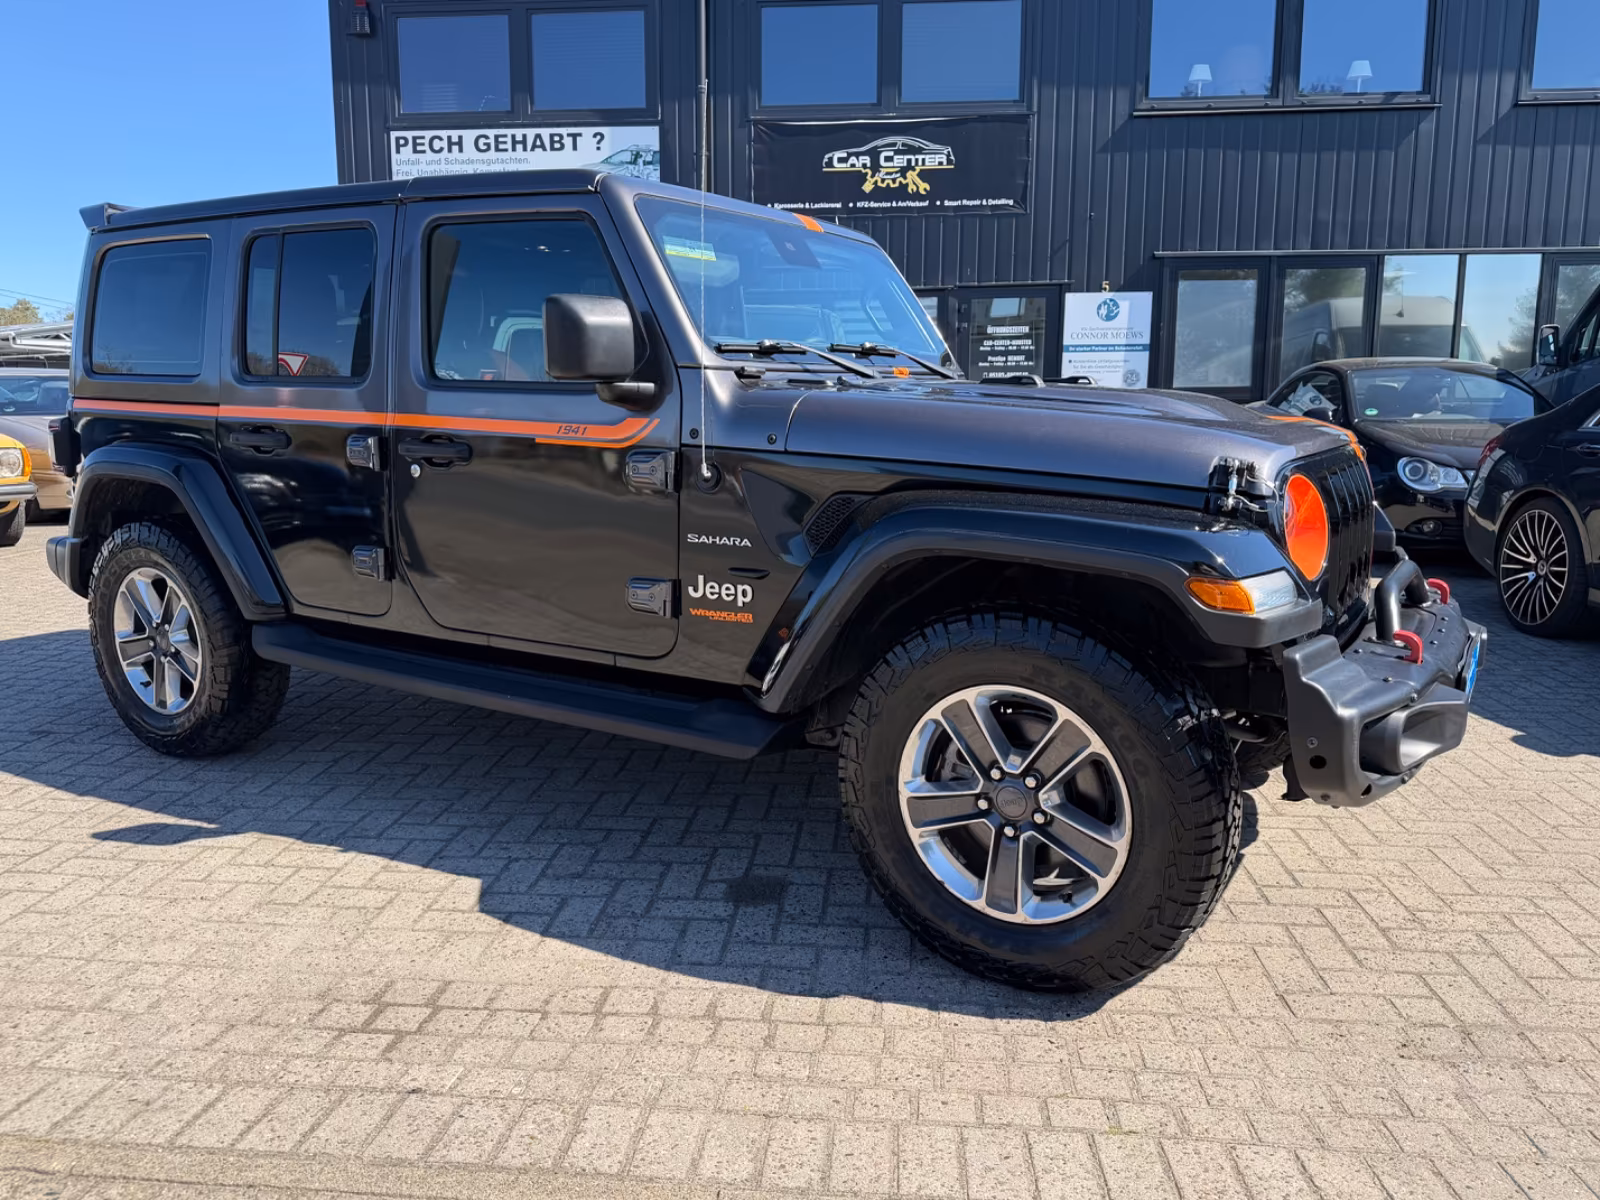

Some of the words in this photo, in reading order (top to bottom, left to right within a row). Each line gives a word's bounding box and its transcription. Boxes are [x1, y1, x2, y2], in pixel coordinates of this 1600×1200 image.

[394, 134, 464, 154] PECH
[474, 132, 583, 153] GEHABT
[592, 131, 605, 151] ?
[395, 157, 423, 166] Unfall-
[425, 156, 442, 165] und
[444, 155, 531, 167] Schadensgutachten.
[832, 152, 871, 168] CAR
[879, 151, 947, 167] CENTER
[396, 169, 415, 177] Frei.
[1101, 280, 1110, 293] 5
[1070, 332, 1109, 340] CONNOR
[1110, 331, 1144, 340] MOEWS
[556, 425, 588, 436] 1941
[687, 533, 752, 547] SAHARA
[687, 574, 754, 607] Jeep
[689, 608, 753, 620] WRANGLER
